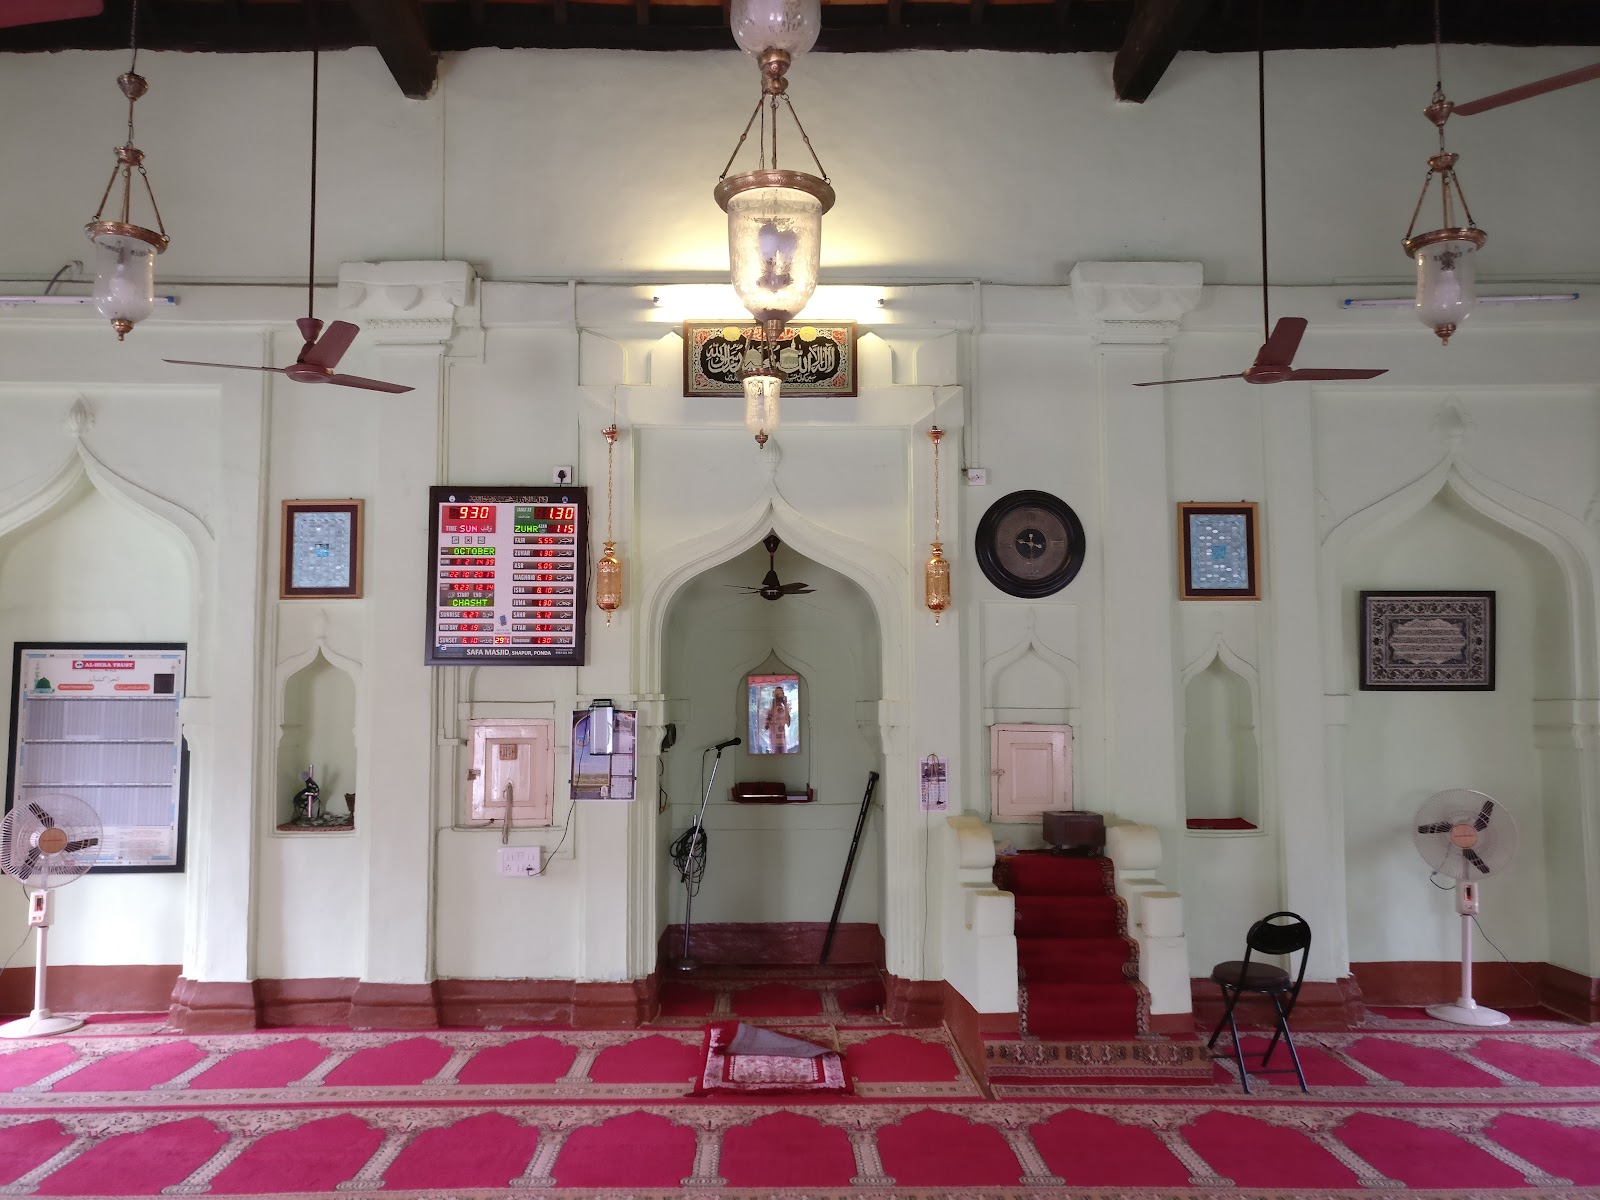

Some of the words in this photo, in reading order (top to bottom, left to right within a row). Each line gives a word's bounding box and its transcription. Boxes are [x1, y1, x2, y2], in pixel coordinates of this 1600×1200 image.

[515, 525, 539, 533] ZUHR
[453, 547, 495, 555] OCTOBER
[452, 598, 488, 607] CHASHT
[466, 648, 485, 656] SAFA
